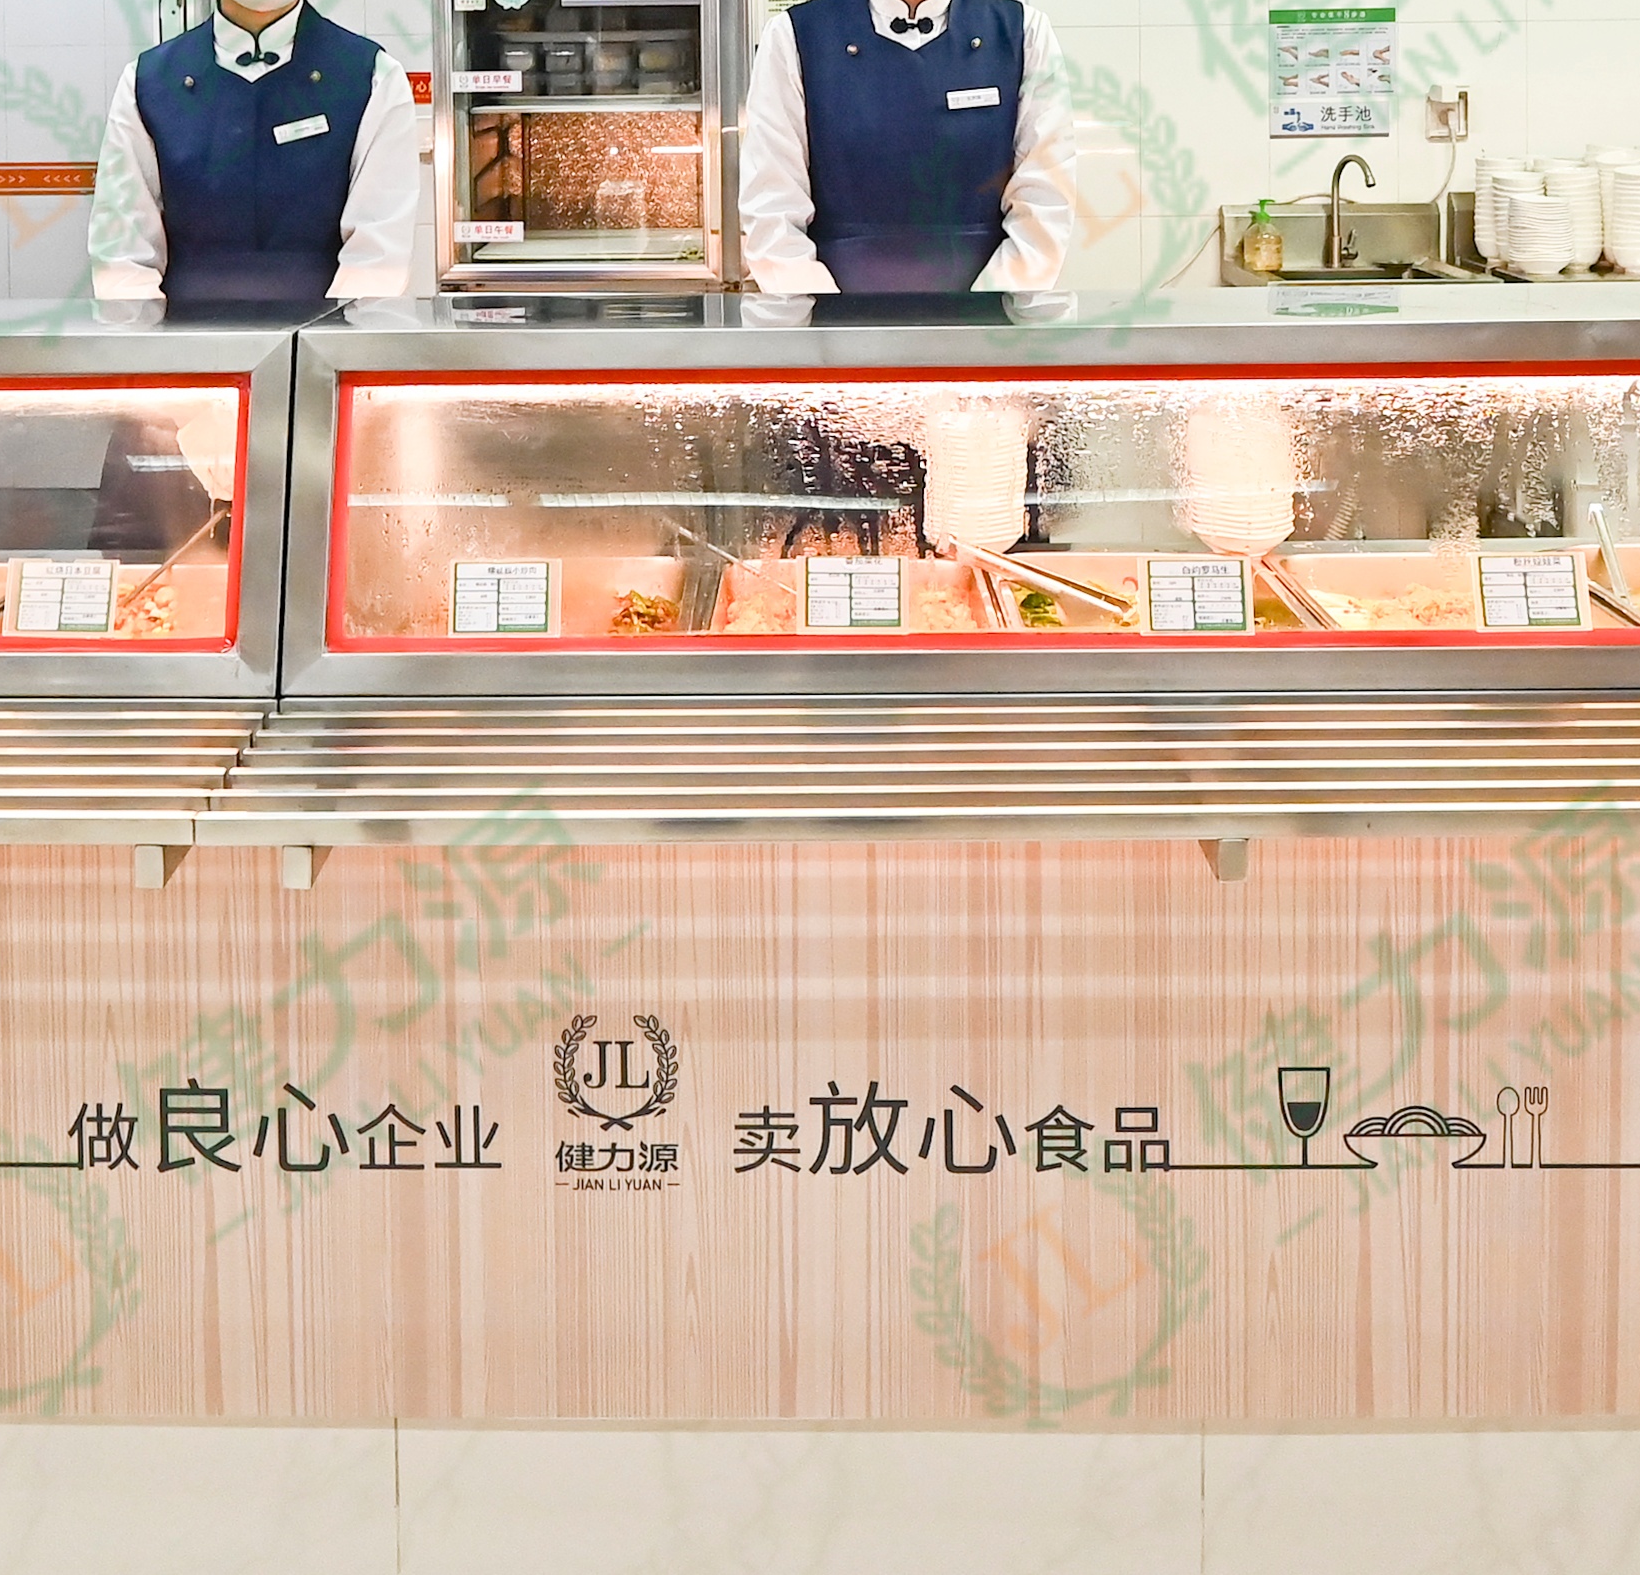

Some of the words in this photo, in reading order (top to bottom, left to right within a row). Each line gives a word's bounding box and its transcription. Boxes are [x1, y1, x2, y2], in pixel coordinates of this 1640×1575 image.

[1320, 106, 1373, 123] 洗手池
[583, 1041, 650, 1088] JL
[68, 1079, 503, 1176] 做良心企业
[732, 1080, 1173, 1177] 卖放心食品
[555, 1141, 679, 1173] 健力源
[572, 1178, 604, 1191] JIAN
[609, 1178, 621, 1191] LI
[625, 1178, 662, 1191] YUAN
